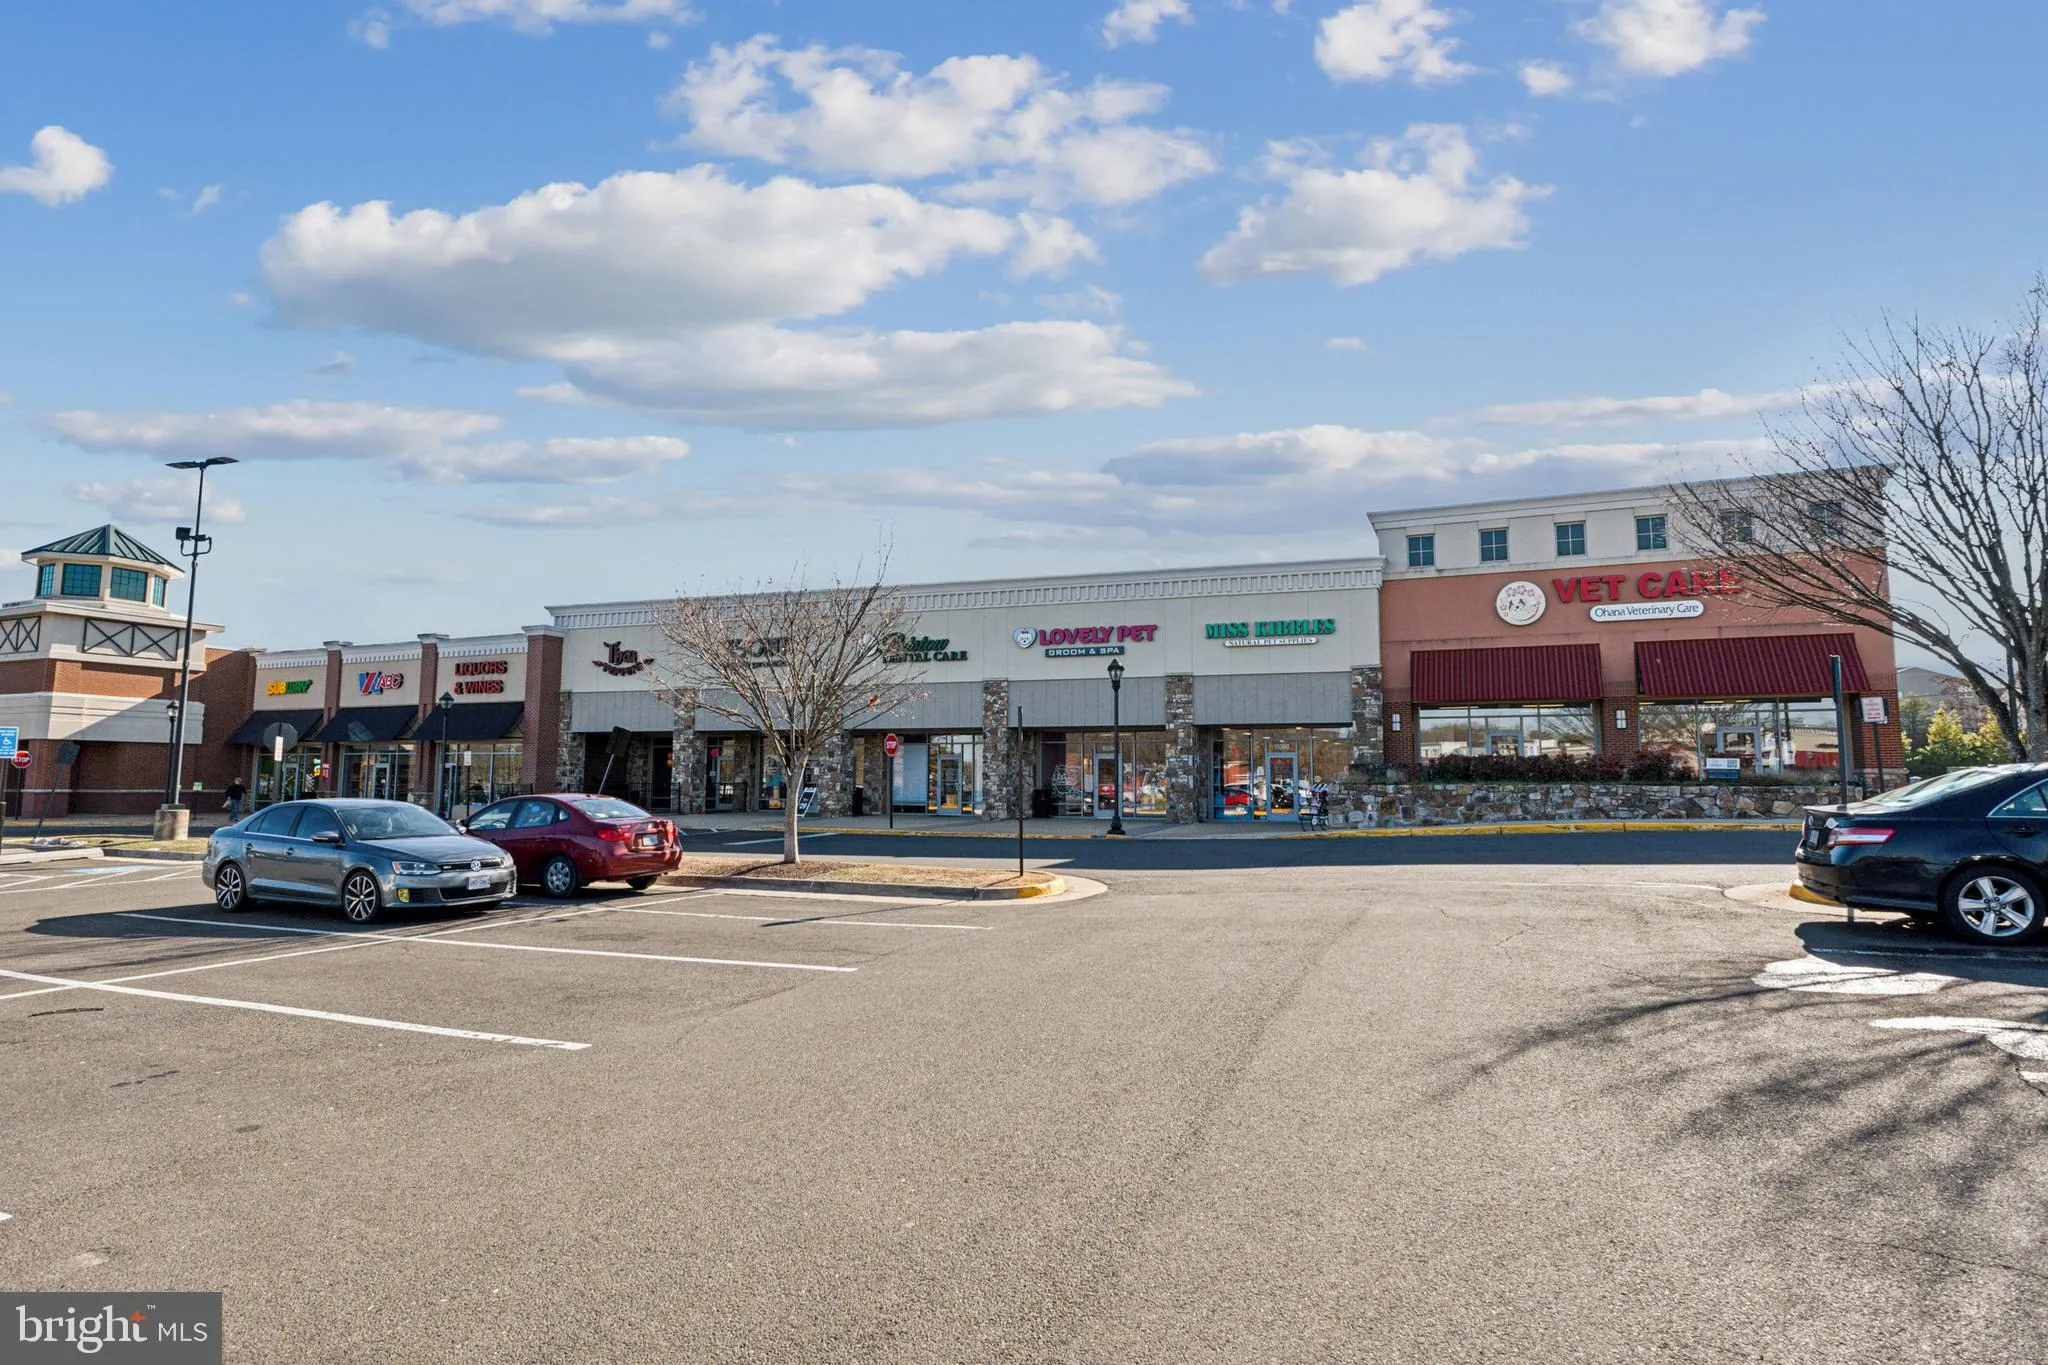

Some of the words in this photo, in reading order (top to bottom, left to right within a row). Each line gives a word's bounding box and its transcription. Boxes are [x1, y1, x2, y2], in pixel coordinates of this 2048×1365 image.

[1553, 575, 1625, 604] VET
[1636, 568, 1744, 599] CARE
[1594, 606, 1626, 618] Ohana
[1626, 603, 1675, 616] Veterinary
[1676, 602, 1699, 613] Care
[1038, 626, 1112, 646] LOVELY
[1116, 624, 1158, 643] PET
[1205, 622, 1249, 639] MISS
[1254, 618, 1337, 637] KIBBLES
[932, 650, 968, 662] CARE
[1048, 649, 1086, 657] GROOM
[1099, 647, 1121, 655] SPA
[455, 660, 508, 677] LIQUORS
[266, 679, 312, 696] SUBWAY
[376, 672, 404, 689] ABC
[454, 681, 464, 695] &
[465, 680, 504, 694] WINES
